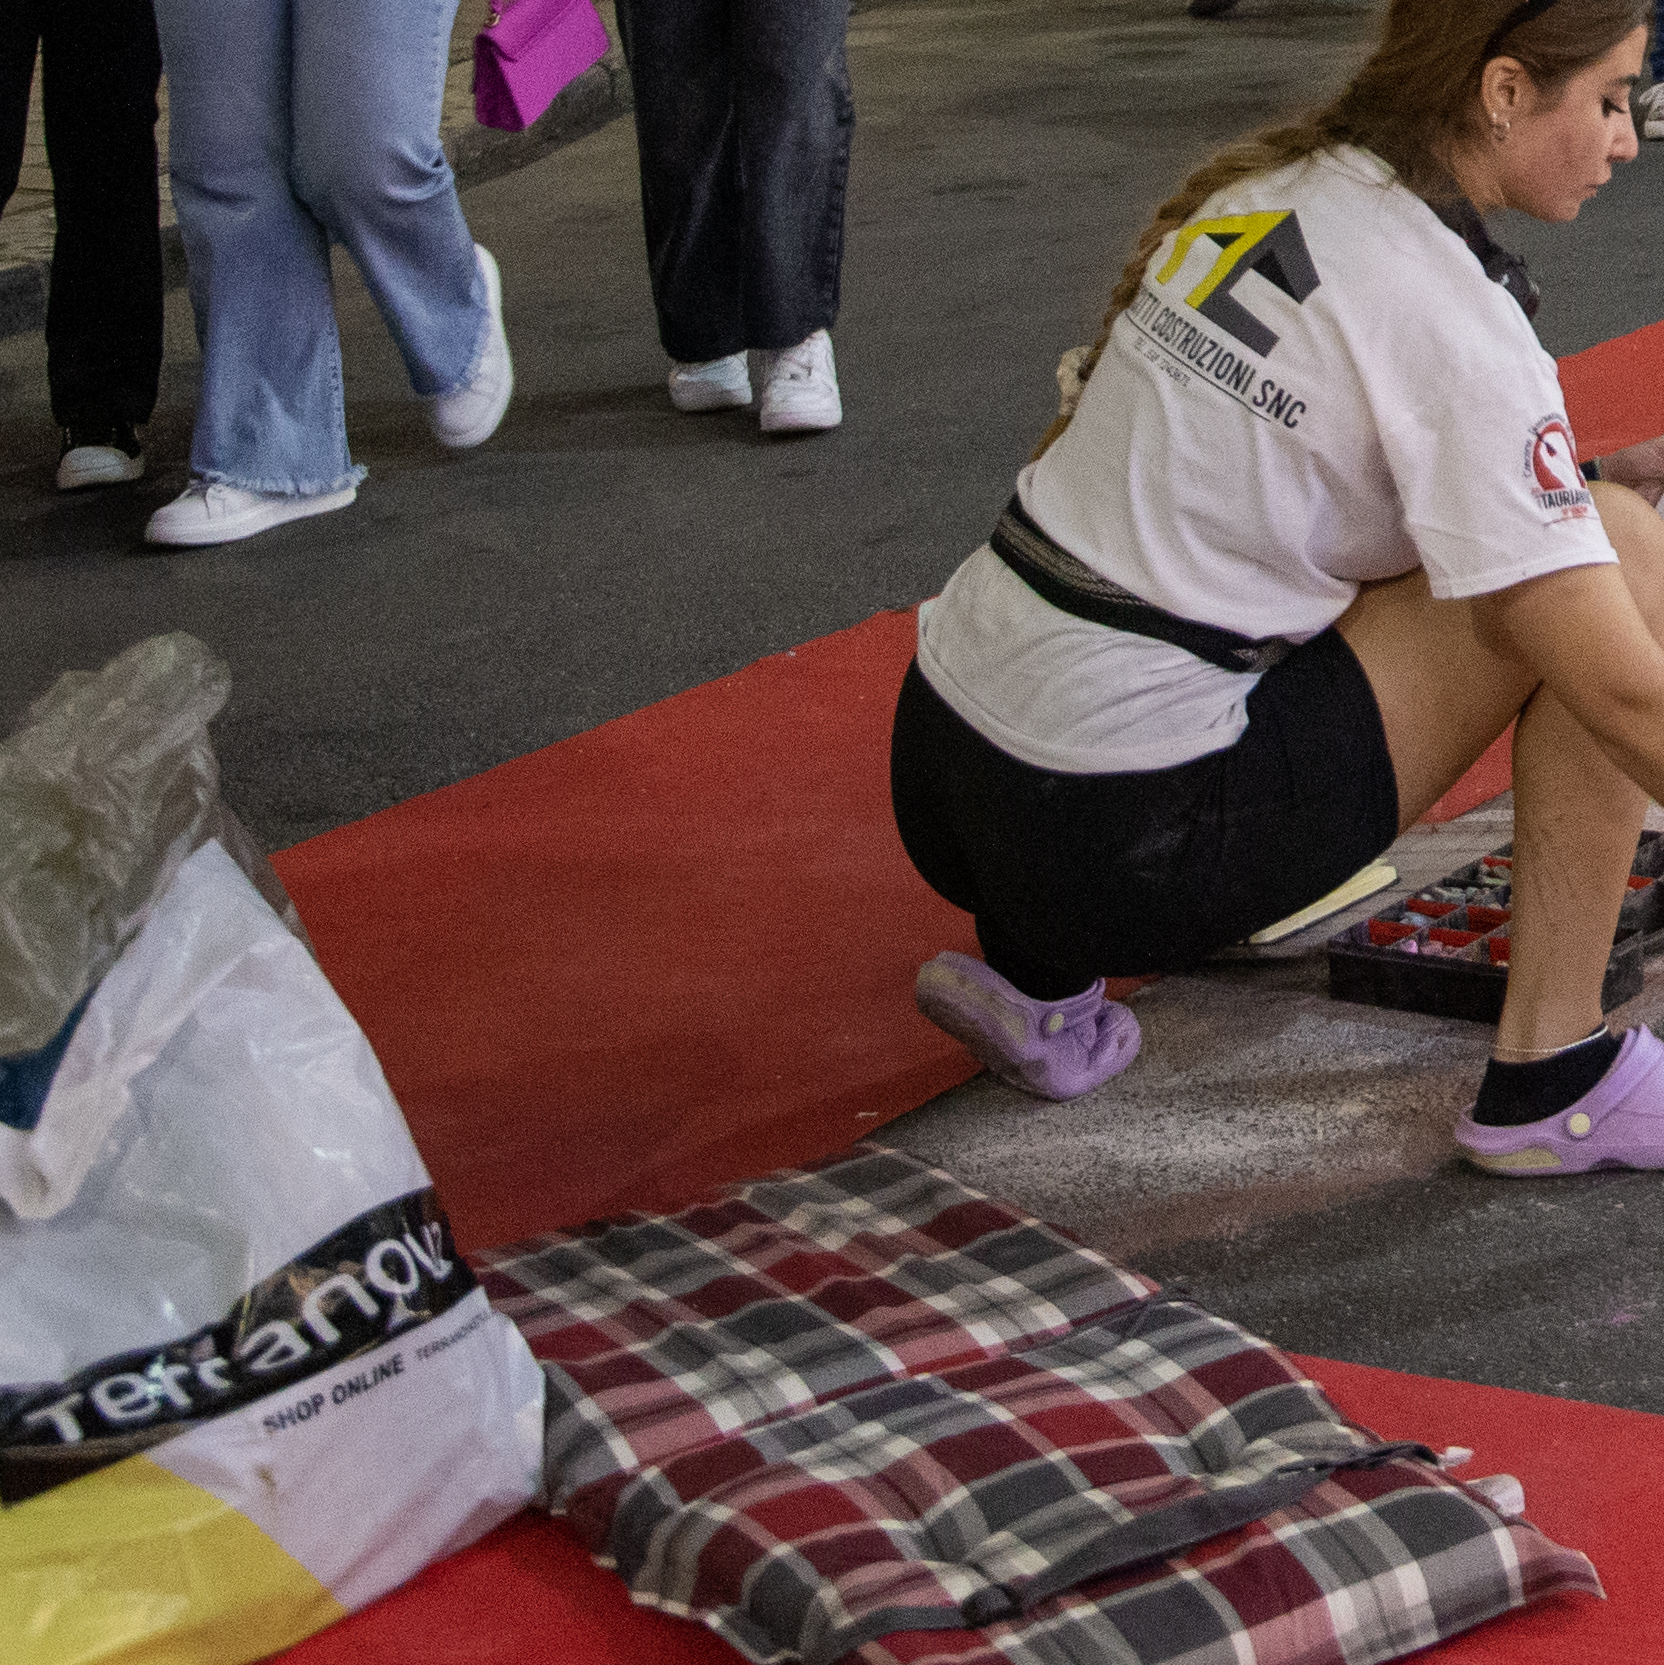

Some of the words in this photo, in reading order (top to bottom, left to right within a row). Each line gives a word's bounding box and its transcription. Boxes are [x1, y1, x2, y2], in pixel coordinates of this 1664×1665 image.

[1151, 306, 1257, 396] COSTRUZIONI
[1252, 379, 1307, 429] SNC
[263, 1392, 326, 1433] SHOP
[331, 1353, 405, 1406] ONLINE
